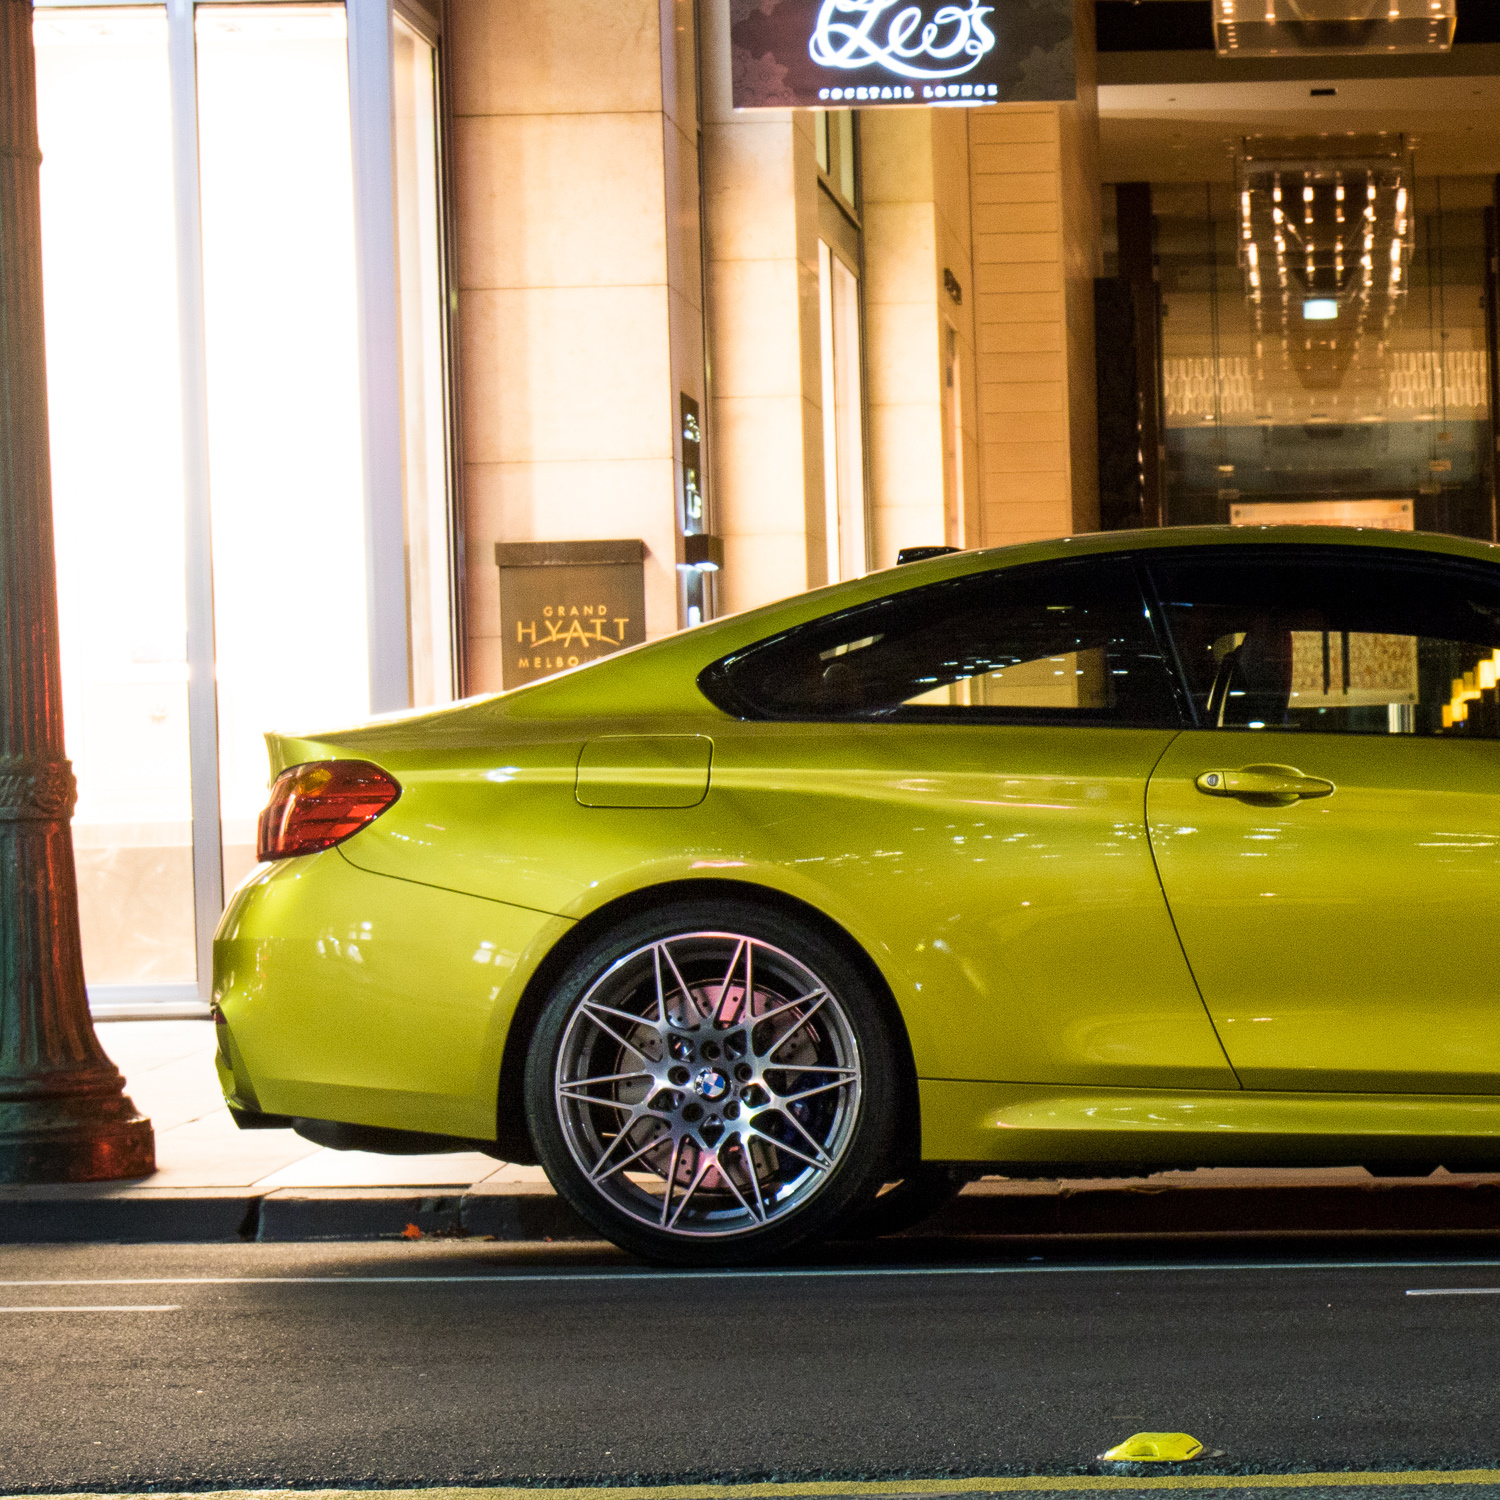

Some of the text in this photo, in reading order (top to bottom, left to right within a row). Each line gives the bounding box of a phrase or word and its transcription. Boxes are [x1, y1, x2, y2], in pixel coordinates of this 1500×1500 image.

[818, 84, 998, 100] COCKTAIL LOUNGE
[543, 605, 607, 617] GRAND
[517, 618, 630, 648] HYATT
